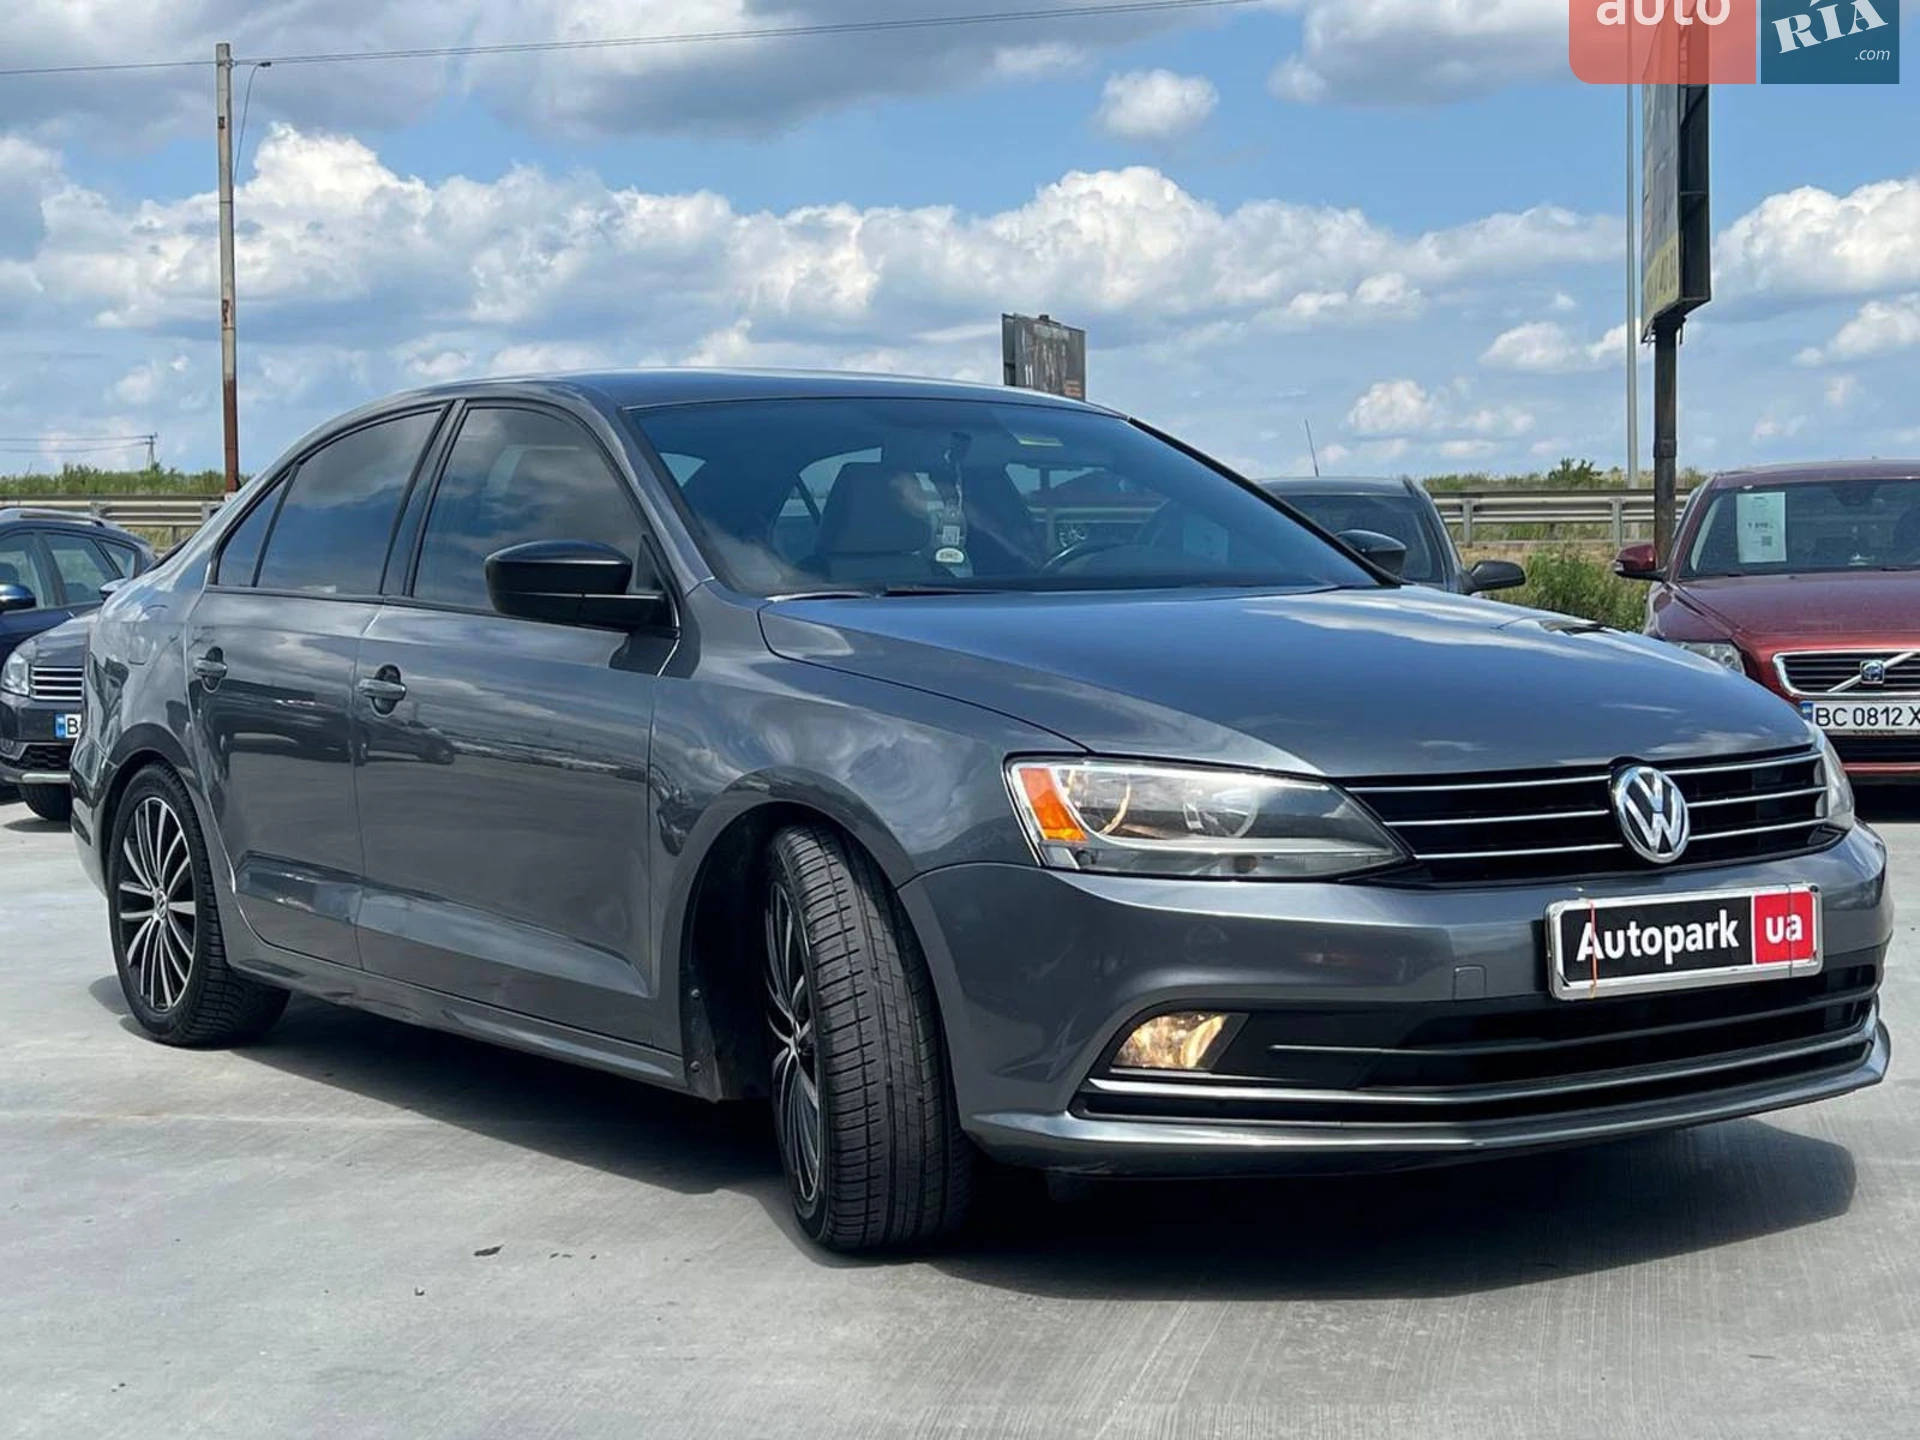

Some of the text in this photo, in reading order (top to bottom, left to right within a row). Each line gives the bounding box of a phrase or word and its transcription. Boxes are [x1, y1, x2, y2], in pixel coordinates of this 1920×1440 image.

[1815, 707, 1848, 727] BC
[1852, 706, 1903, 727] 0812
[1576, 909, 1804, 965] Autopark ua
